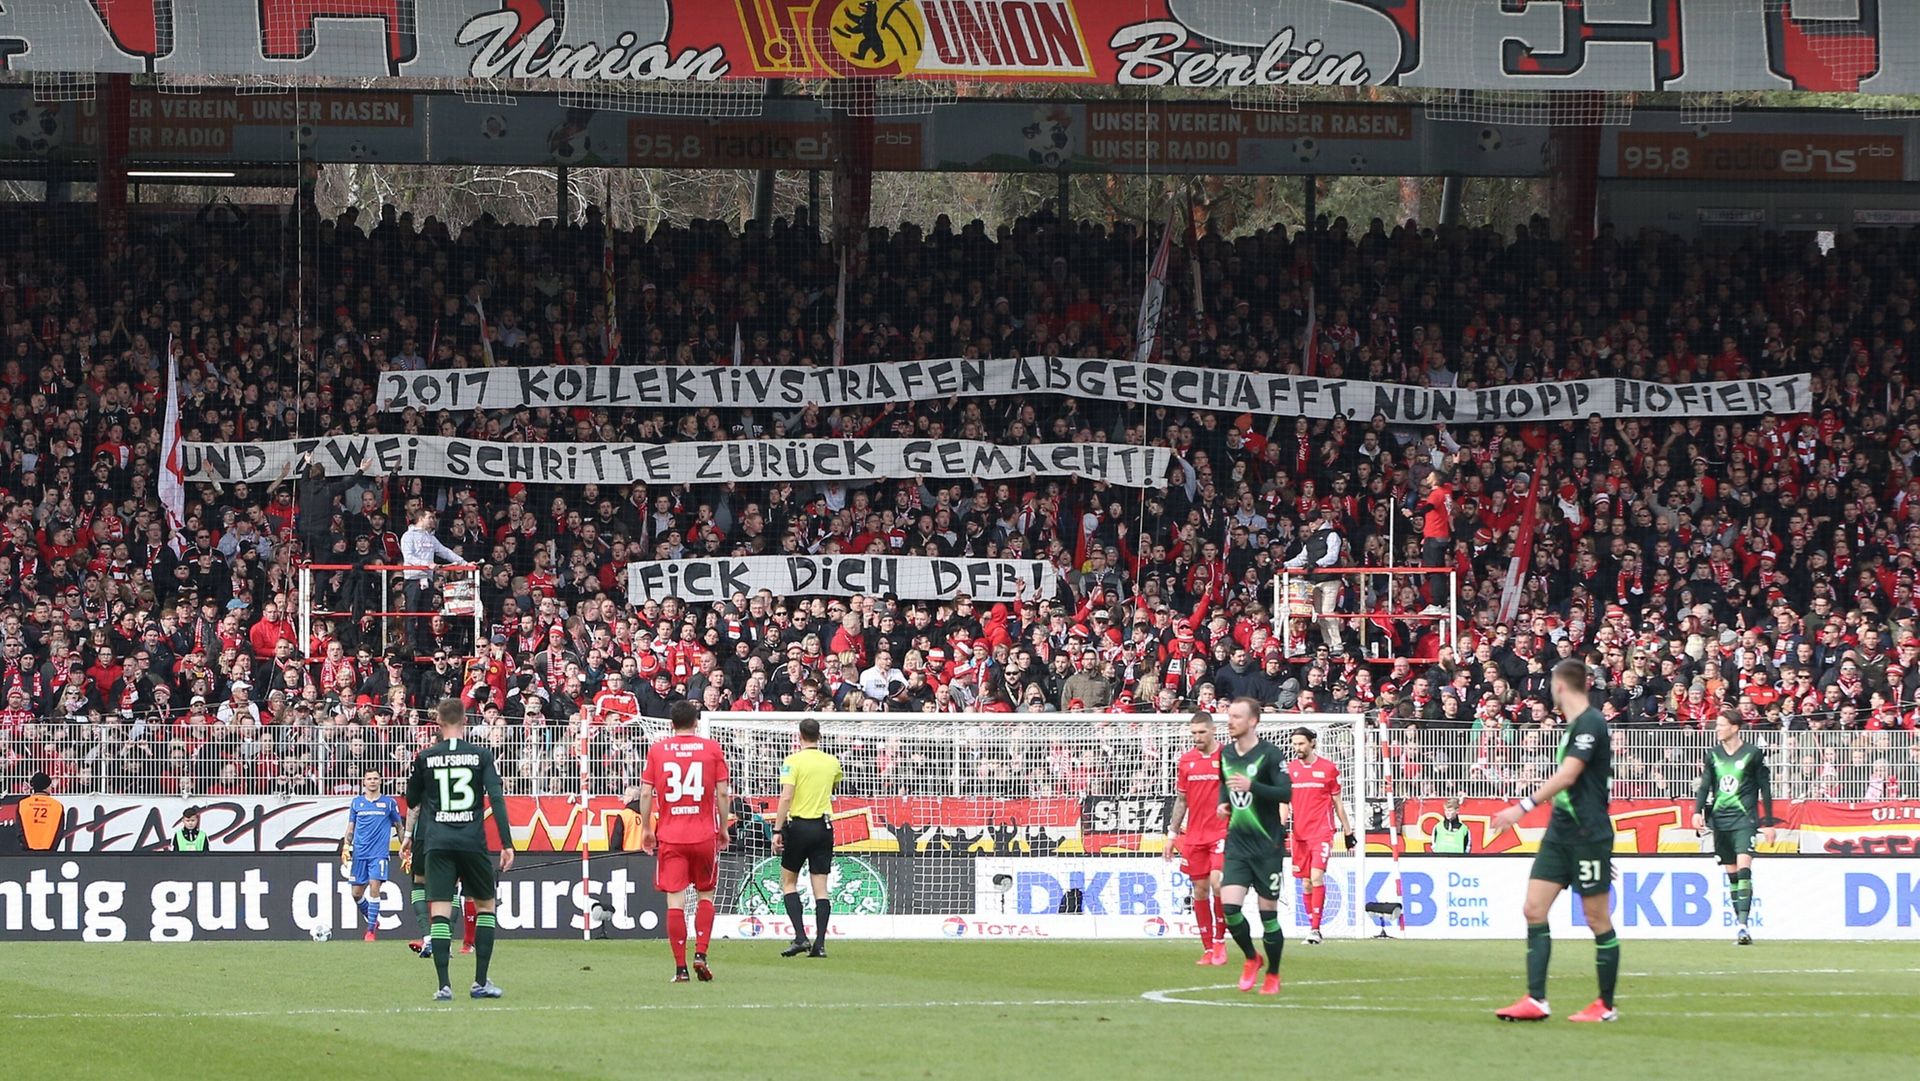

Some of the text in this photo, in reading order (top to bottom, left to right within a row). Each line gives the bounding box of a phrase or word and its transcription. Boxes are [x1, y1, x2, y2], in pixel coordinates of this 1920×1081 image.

[456, 10, 730, 80] Union
[924, 1, 1085, 67] UNION
[1110, 20, 1370, 86] Berlin
[83, 99, 406, 124] UER VEREIN, UNSER RASEN,
[1092, 111, 1405, 136] UNSER VEREIN, UNSER RASEN,
[83, 127, 225, 146] UER RADIO
[633, 134, 701, 162] 95,8
[875, 131, 912, 146] rbb
[1092, 139, 1230, 160] UNSER RADIO
[1624, 146, 1690, 173] 95,8
[1857, 144, 1895, 157] rbb
[386, 371, 490, 406] 2017
[1011, 357, 1356, 420] ABGESCHAFFT,
[1374, 386, 1457, 421] NUN
[1476, 383, 1591, 418] HOPP
[182, 445, 266, 479] UND
[697, 440, 875, 478] ZURÜCK
[903, 440, 1156, 486] GEMACHT!
[680, 742, 704, 751] UNION
[426, 754, 480, 768] WOLFSBURG
[433, 768, 475, 811] 13
[663, 761, 705, 803] 34
[33, 808, 48, 818] 72
[671, 805, 700, 815] GENTNER
[1095, 801, 1165, 831] SEZ
[1448, 872, 1479, 888] Das
[1578, 860, 1601, 881] 31
[149, 868, 270, 942] gut
[292, 862, 403, 930] die
[1016, 871, 1160, 915] DKB
[1448, 891, 1488, 907] kann
[972, 921, 1048, 936] TOTAL
[1448, 911, 1490, 927] Bank
